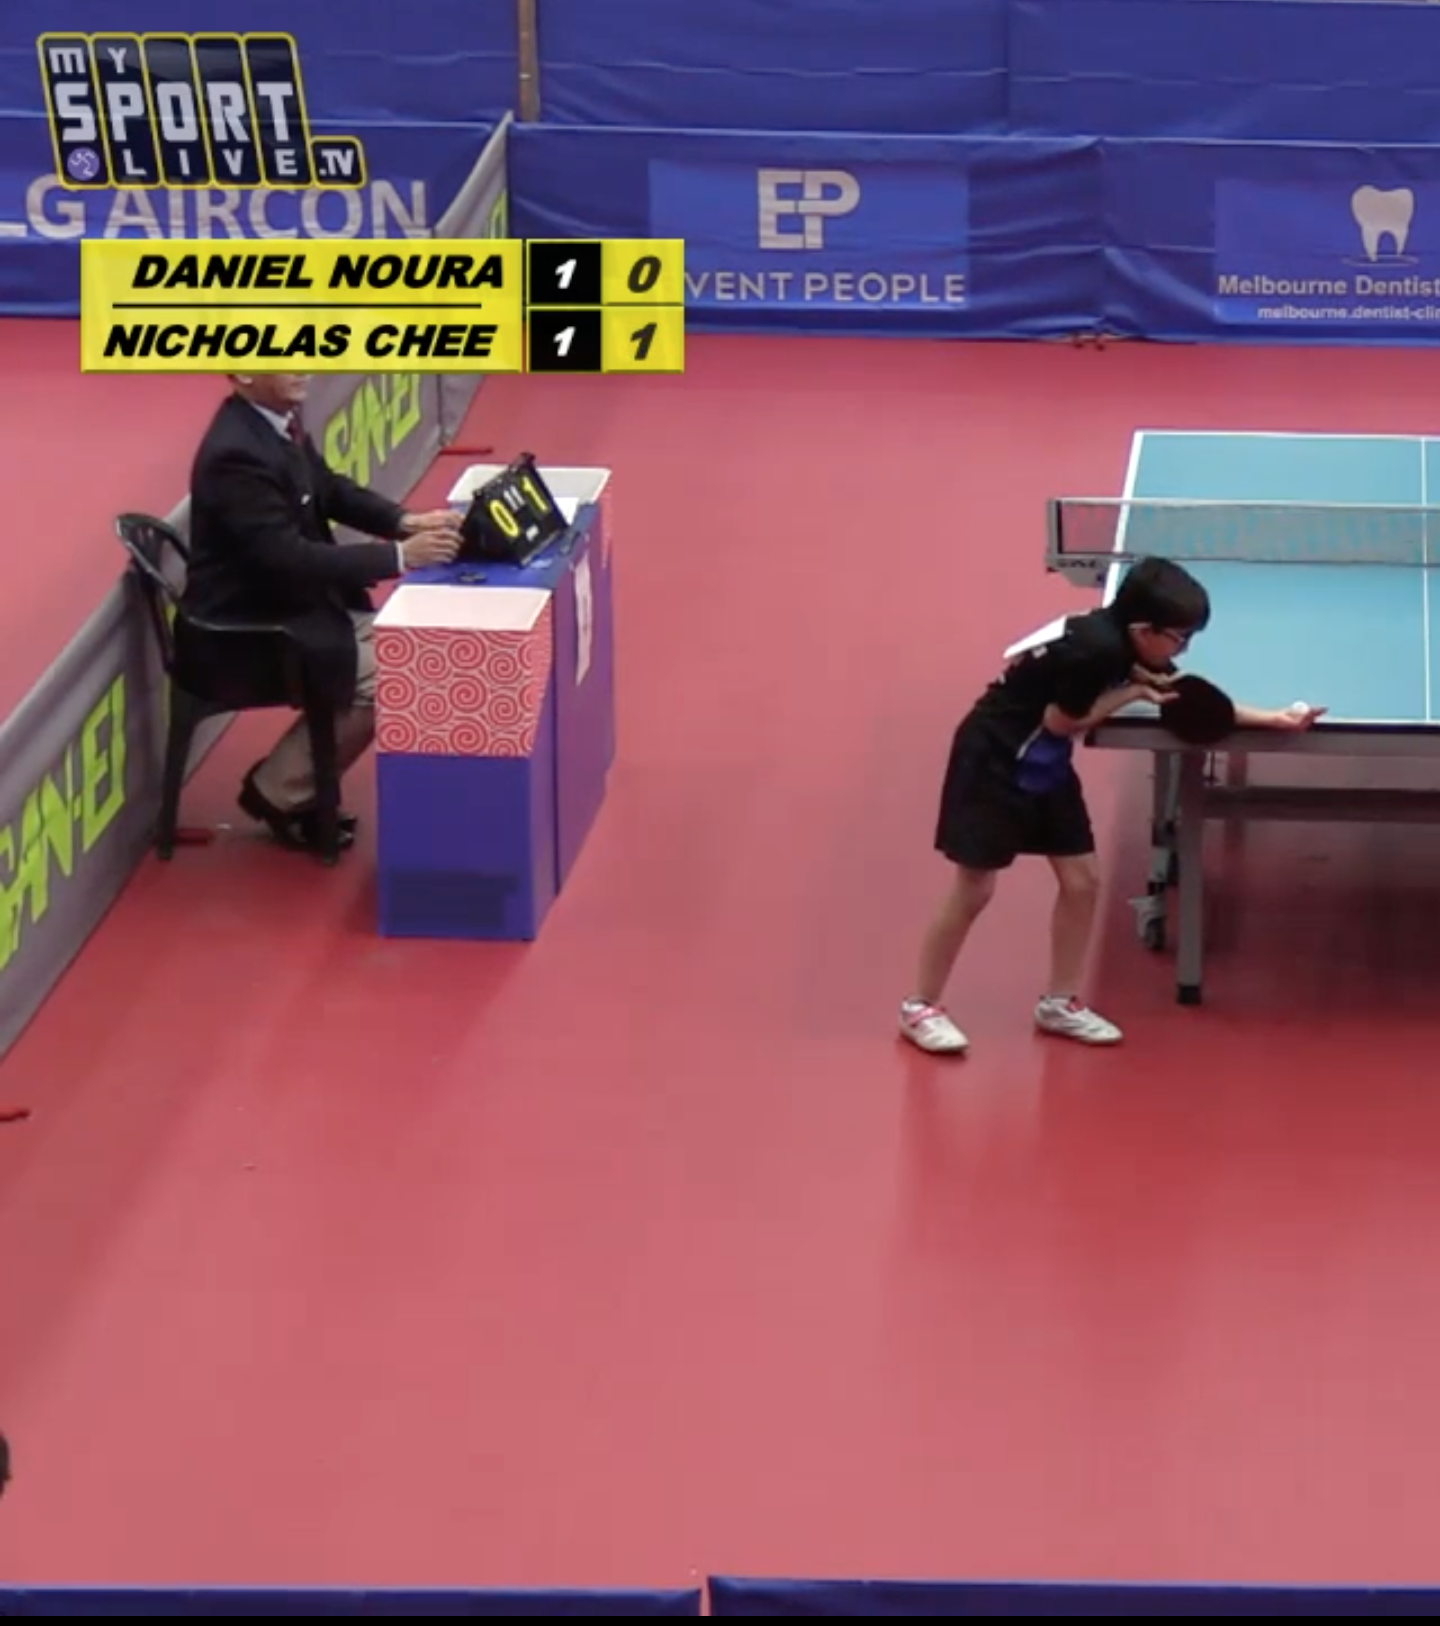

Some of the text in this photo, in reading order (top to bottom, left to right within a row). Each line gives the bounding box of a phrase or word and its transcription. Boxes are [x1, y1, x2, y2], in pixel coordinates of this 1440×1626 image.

[0, 173, 86, 238] G
[102, 180, 430, 239] AIRCON
[757, 168, 861, 250] EP
[804, 271, 967, 303] PEOPLE
[1217, 275, 1348, 295] Melbourne
